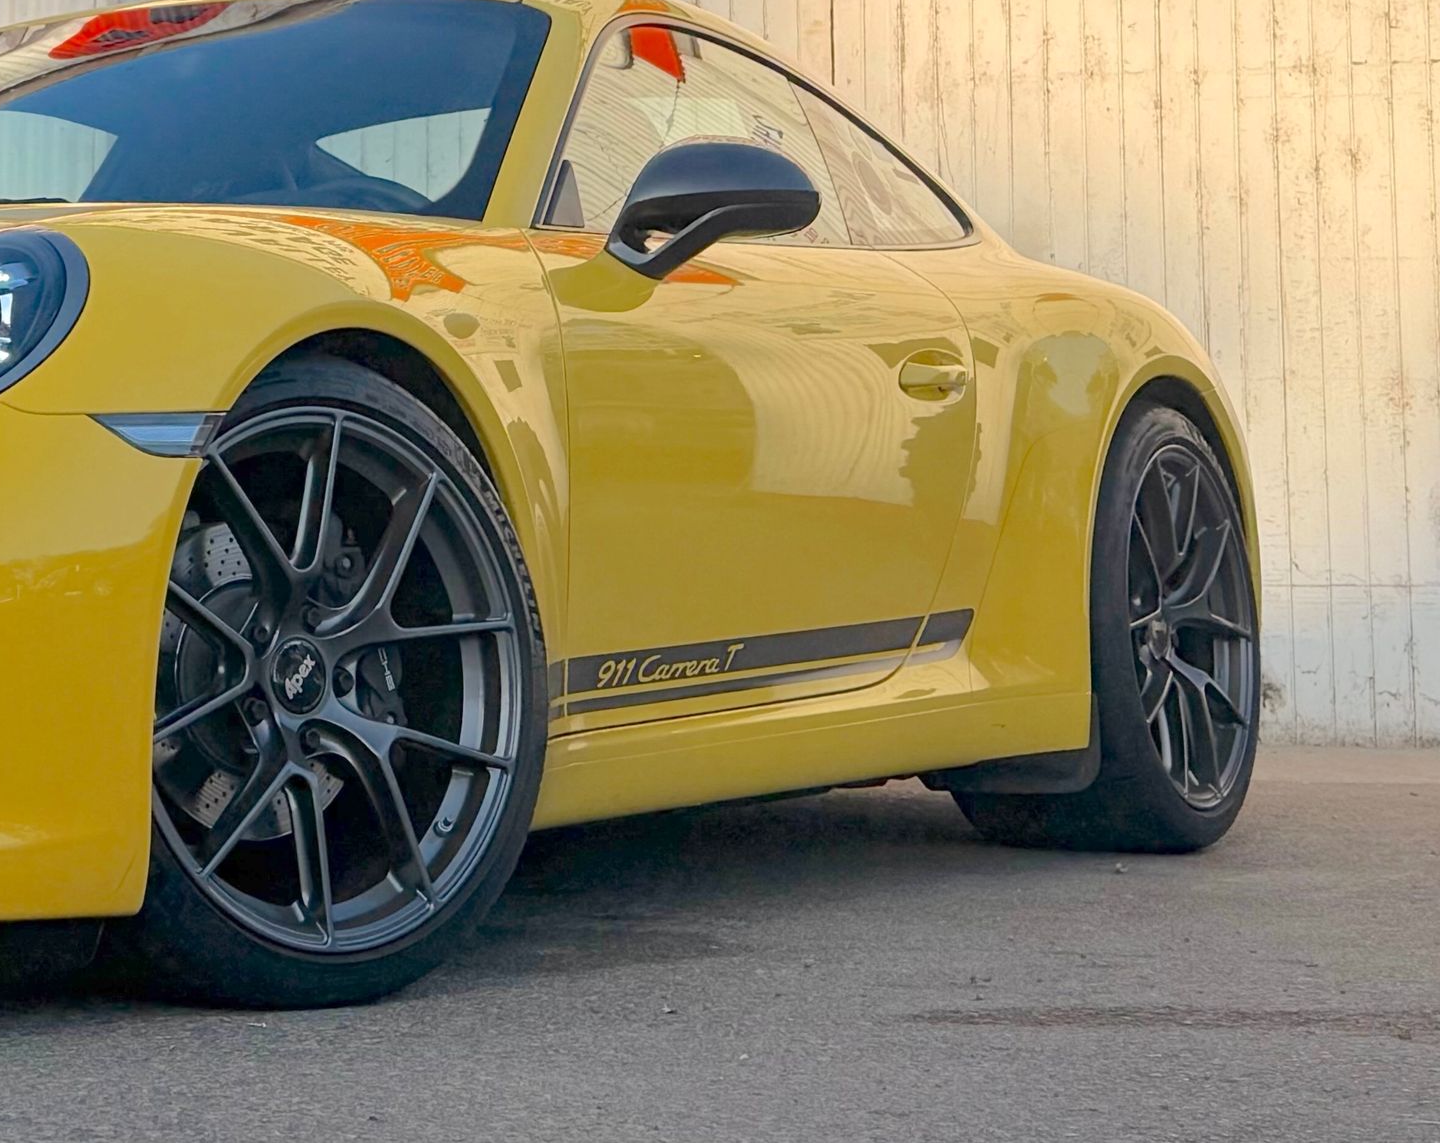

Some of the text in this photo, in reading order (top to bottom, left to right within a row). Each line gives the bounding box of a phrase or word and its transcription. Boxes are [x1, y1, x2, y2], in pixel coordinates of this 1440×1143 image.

[284, 653, 316, 701] Apex
[596, 643, 745, 689] 911 Carrera T
